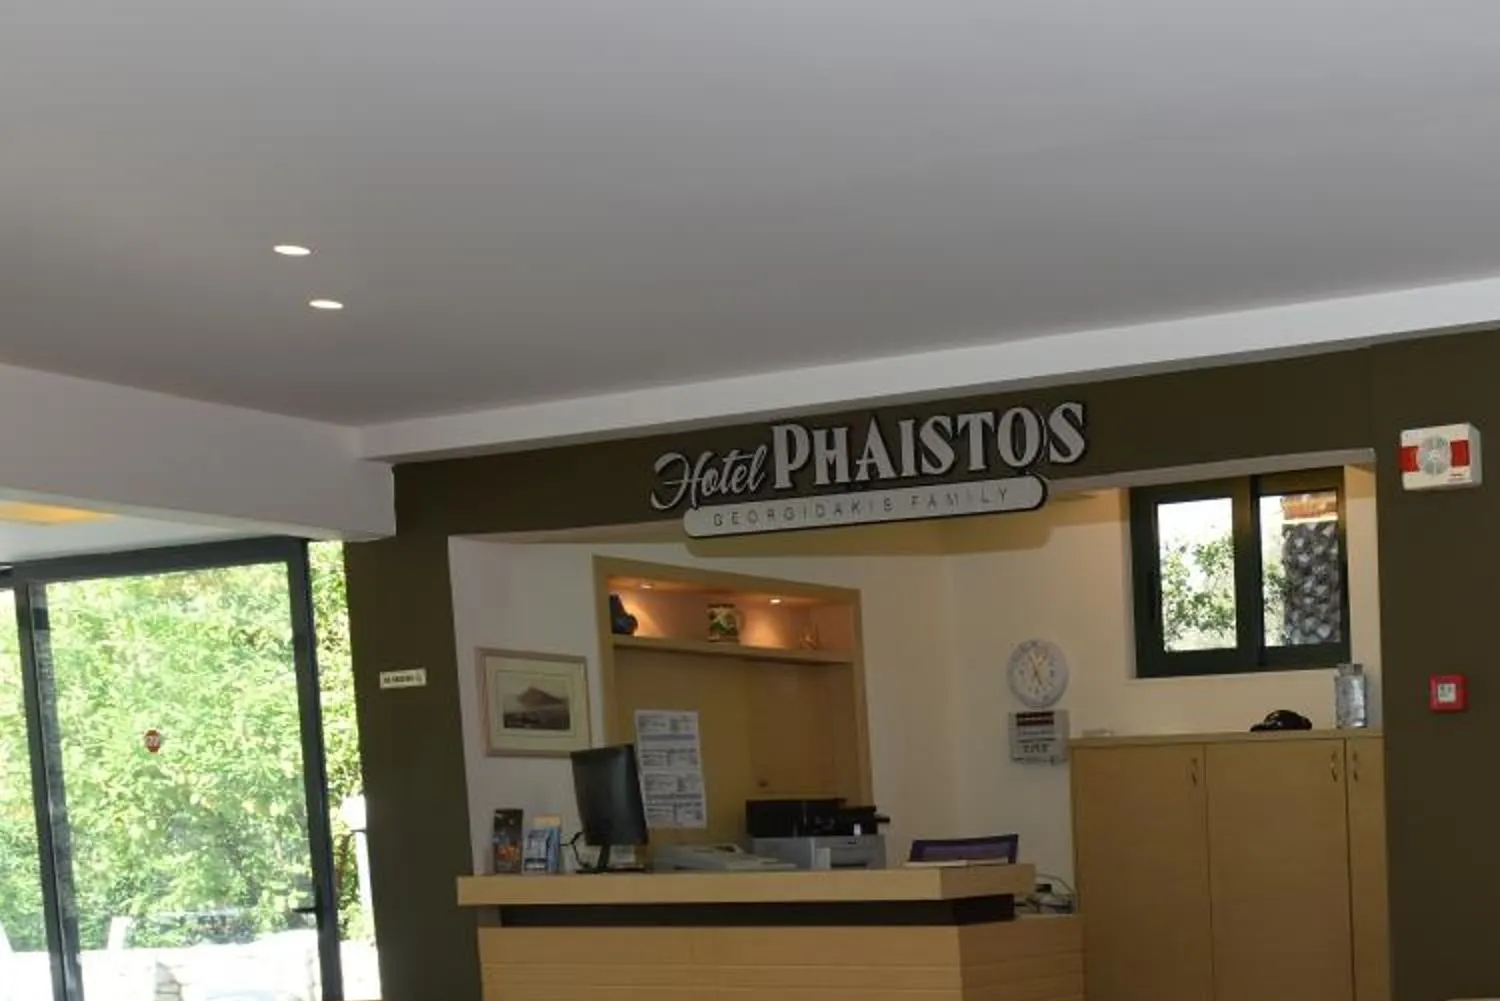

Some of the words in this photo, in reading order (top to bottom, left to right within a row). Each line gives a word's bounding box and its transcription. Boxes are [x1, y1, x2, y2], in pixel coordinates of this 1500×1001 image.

[650, 444, 768, 511] Hotel
[771, 401, 1087, 490] PHAISTOS
[712, 497, 895, 527] GEORGIDAKIS
[910, 487, 1009, 511] FAMILY
